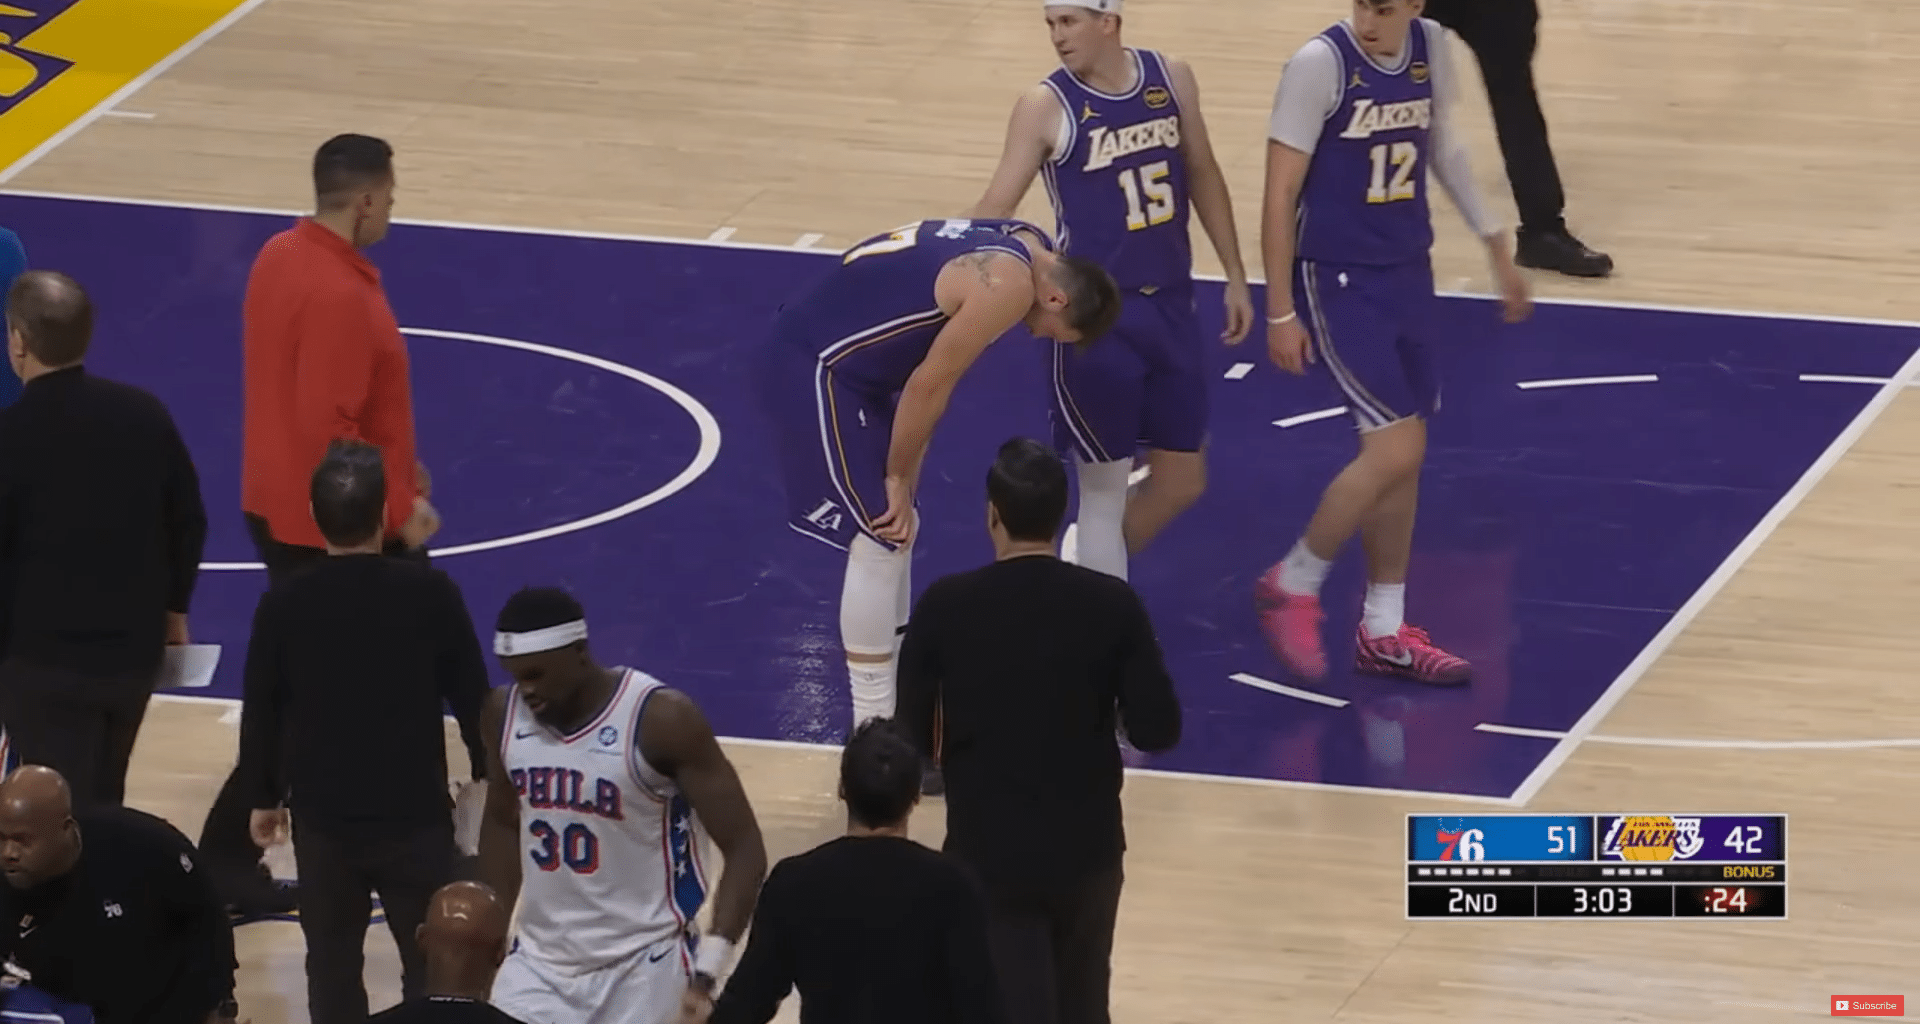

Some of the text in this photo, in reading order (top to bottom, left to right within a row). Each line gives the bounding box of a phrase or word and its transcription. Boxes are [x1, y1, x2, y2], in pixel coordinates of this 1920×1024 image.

[1083, 115, 1180, 172] LAKERS
[1117, 160, 1175, 231] 15
[1366, 141, 1418, 204] 12
[801, 498, 843, 532] LA
[510, 766, 625, 821] PHILA
[528, 819, 599, 875] 30
